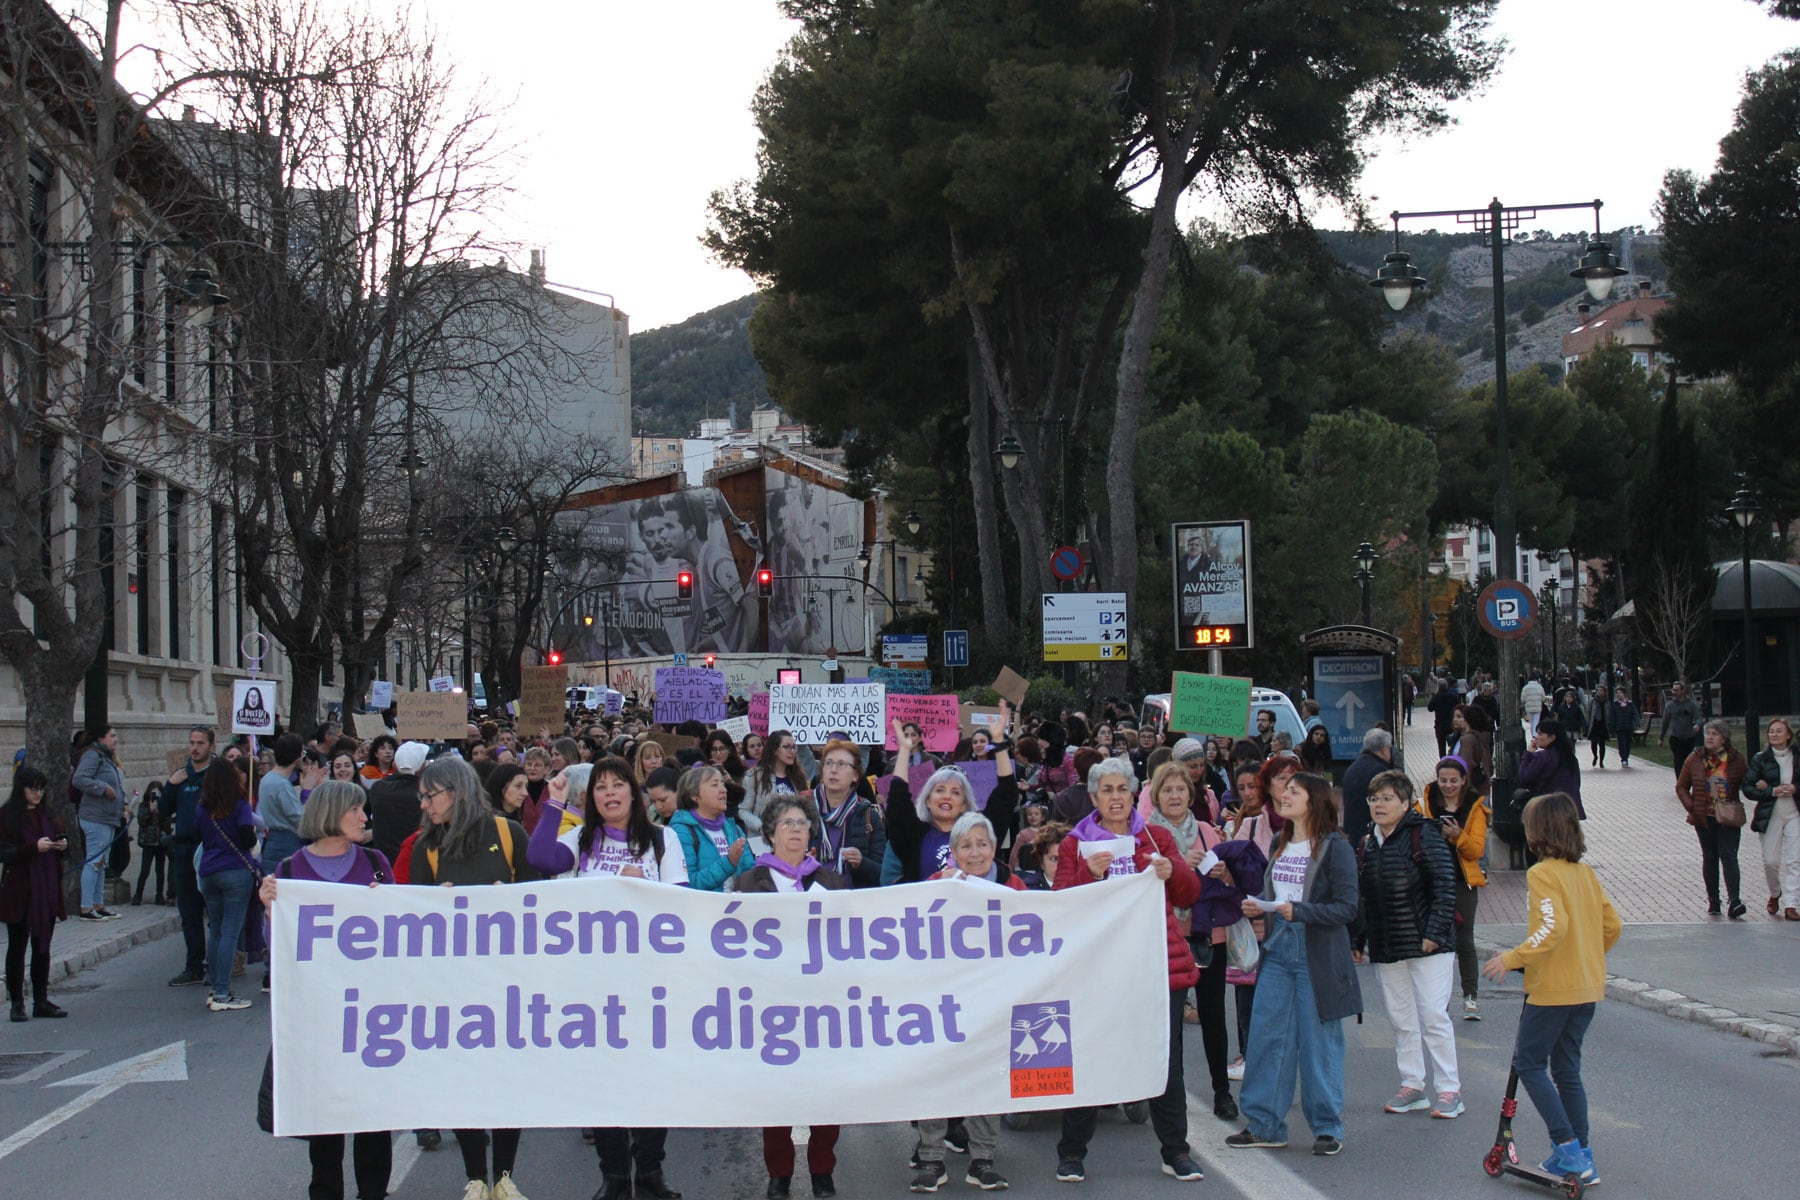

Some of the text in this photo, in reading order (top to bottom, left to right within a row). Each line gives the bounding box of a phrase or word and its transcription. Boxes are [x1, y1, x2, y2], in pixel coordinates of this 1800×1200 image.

[1208, 561, 1240, 572] Alcoy
[1199, 571, 1240, 582] Merece
[1183, 582, 1241, 593] AVANZAR
[1196, 628, 1231, 644] 18 54
[656, 669, 670, 677] NO
[672, 667, 687, 677] ES
[687, 668, 699, 677] UN
[697, 670, 723, 679] CASO
[1321, 662, 1377, 673] DECATHLON
[669, 689, 704, 699] ES EL
[772, 686, 784, 698] SI
[791, 686, 822, 698] ODIAN
[851, 686, 860, 698] A
[862, 685, 879, 697] LAS
[772, 701, 880, 714] FEMINISTAS QUE A LOS
[913, 697, 939, 706] VENGO
[941, 699, 951, 707] DE
[655, 700, 728, 721] PATRIARCADO
[784, 714, 878, 729] VIOLADORES,
[925, 716, 936, 725] DE
[847, 730, 881, 743] MAL
[1273, 872, 1306, 884] REBELS
[296, 893, 1064, 975] Feminisme és justícia,
[1528, 925, 1552, 948] NYC
[342, 985, 967, 1068] igualtat i dignitat
[1022, 1083, 1034, 1093] de
[1037, 1080, 1072, 1092] MARÇ
